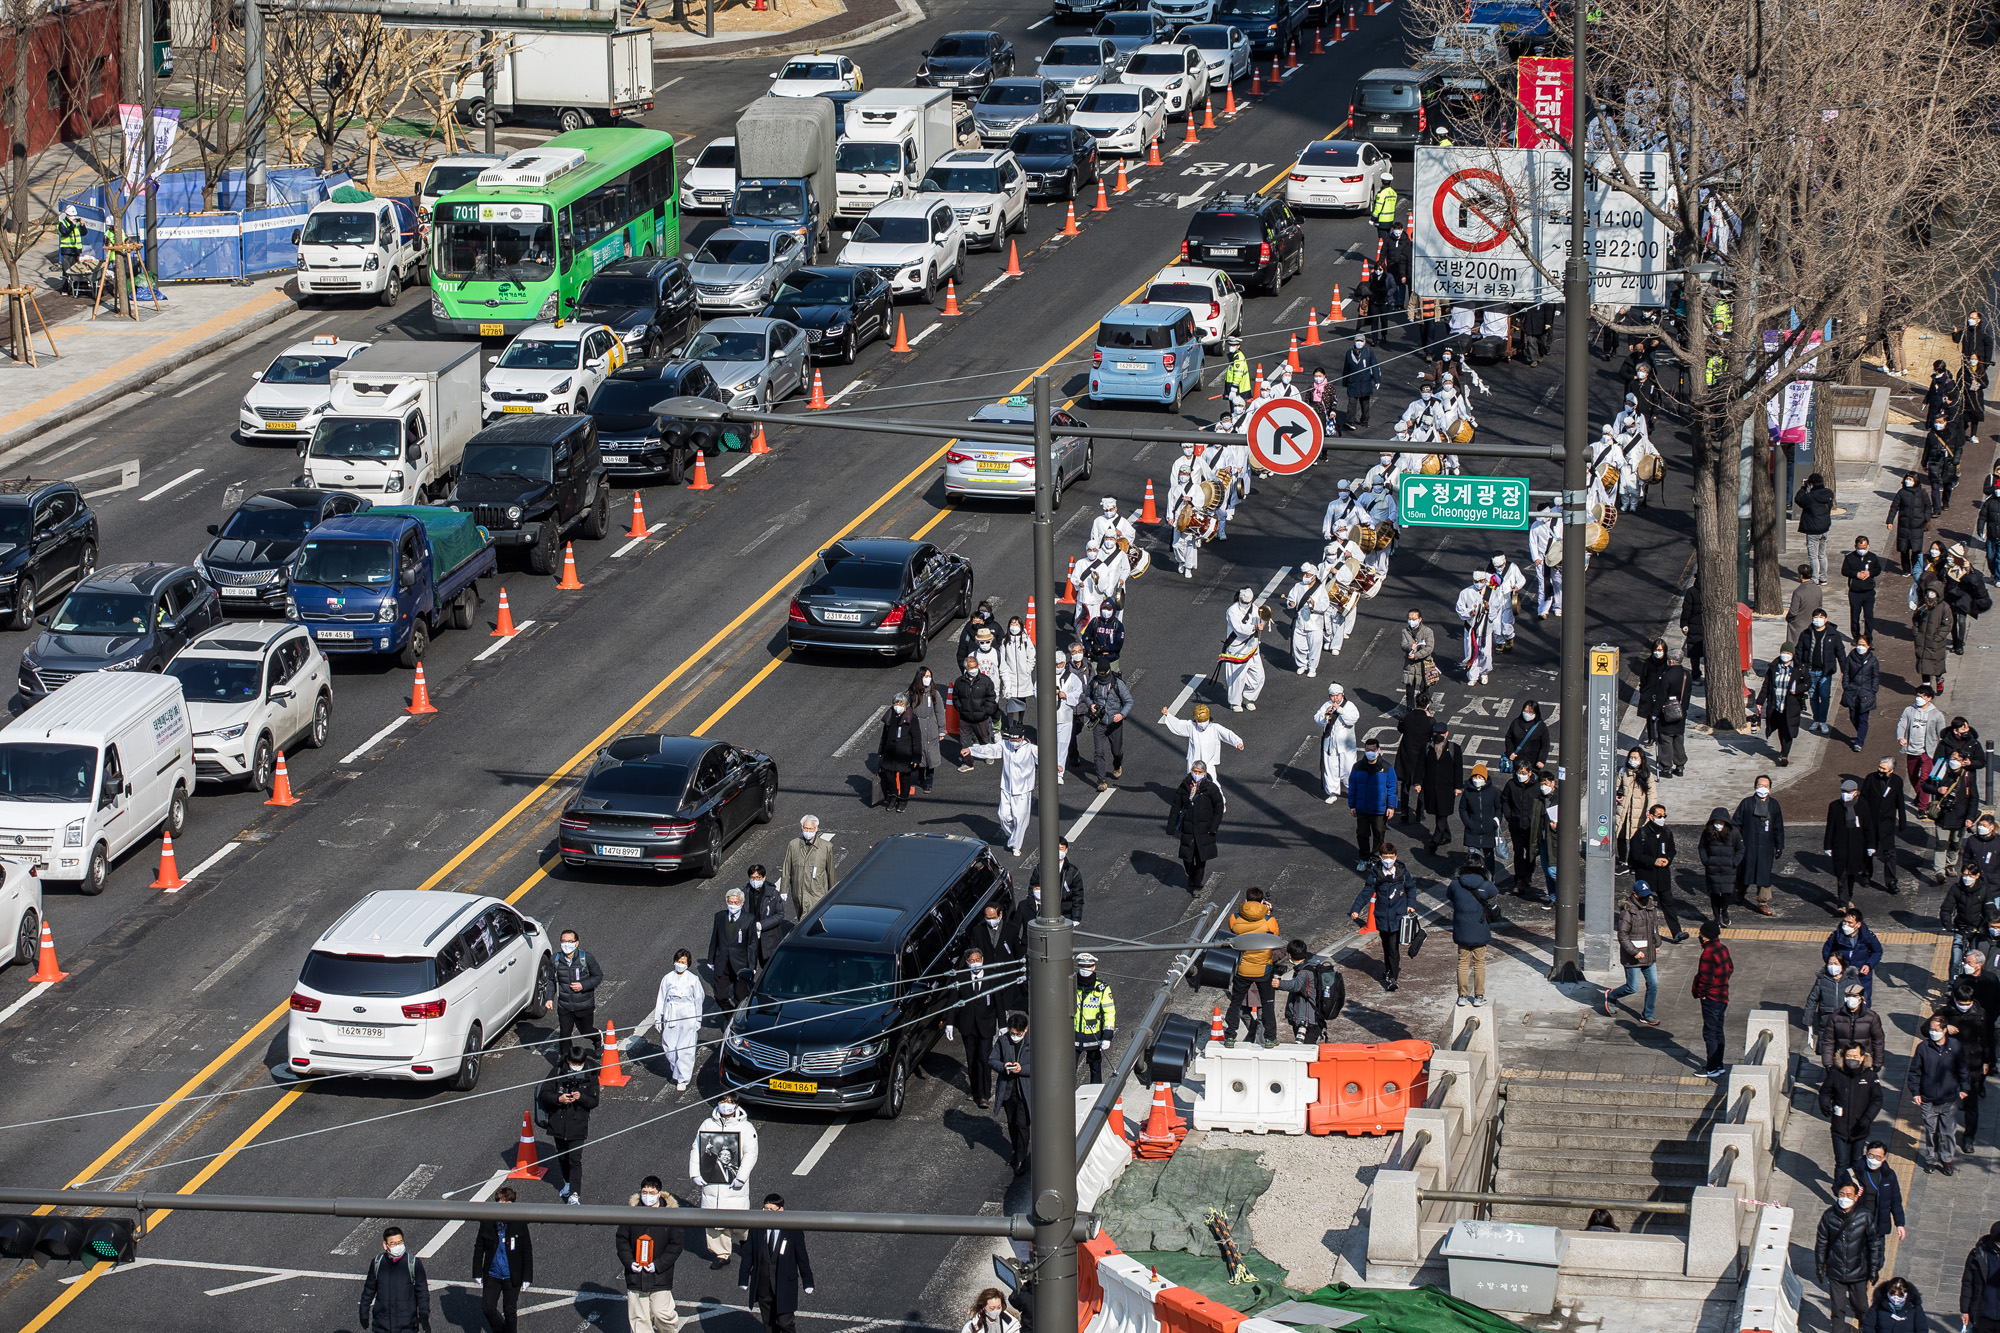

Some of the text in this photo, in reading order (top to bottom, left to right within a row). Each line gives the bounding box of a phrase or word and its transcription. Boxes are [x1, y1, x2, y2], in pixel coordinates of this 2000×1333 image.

[455, 205, 479, 219] 7011
[1434, 260, 1517, 281] 전방200m
[437, 282, 459, 292] 7011
[1433, 279, 1516, 298] (자전거 허용)
[1431, 482, 1521, 507] 청계광장
[1407, 510, 1426, 518] 150m
[1431, 504, 1521, 521] Cheonggye Plaza
[1598, 692, 1612, 731] 지하철
[1599, 734, 1611, 760] 타는
[1598, 763, 1610, 776] 곳
[622, 847, 639, 857] 8997
[362, 1027, 382, 1036] 7898
[794, 1082, 813, 1091] 1861
